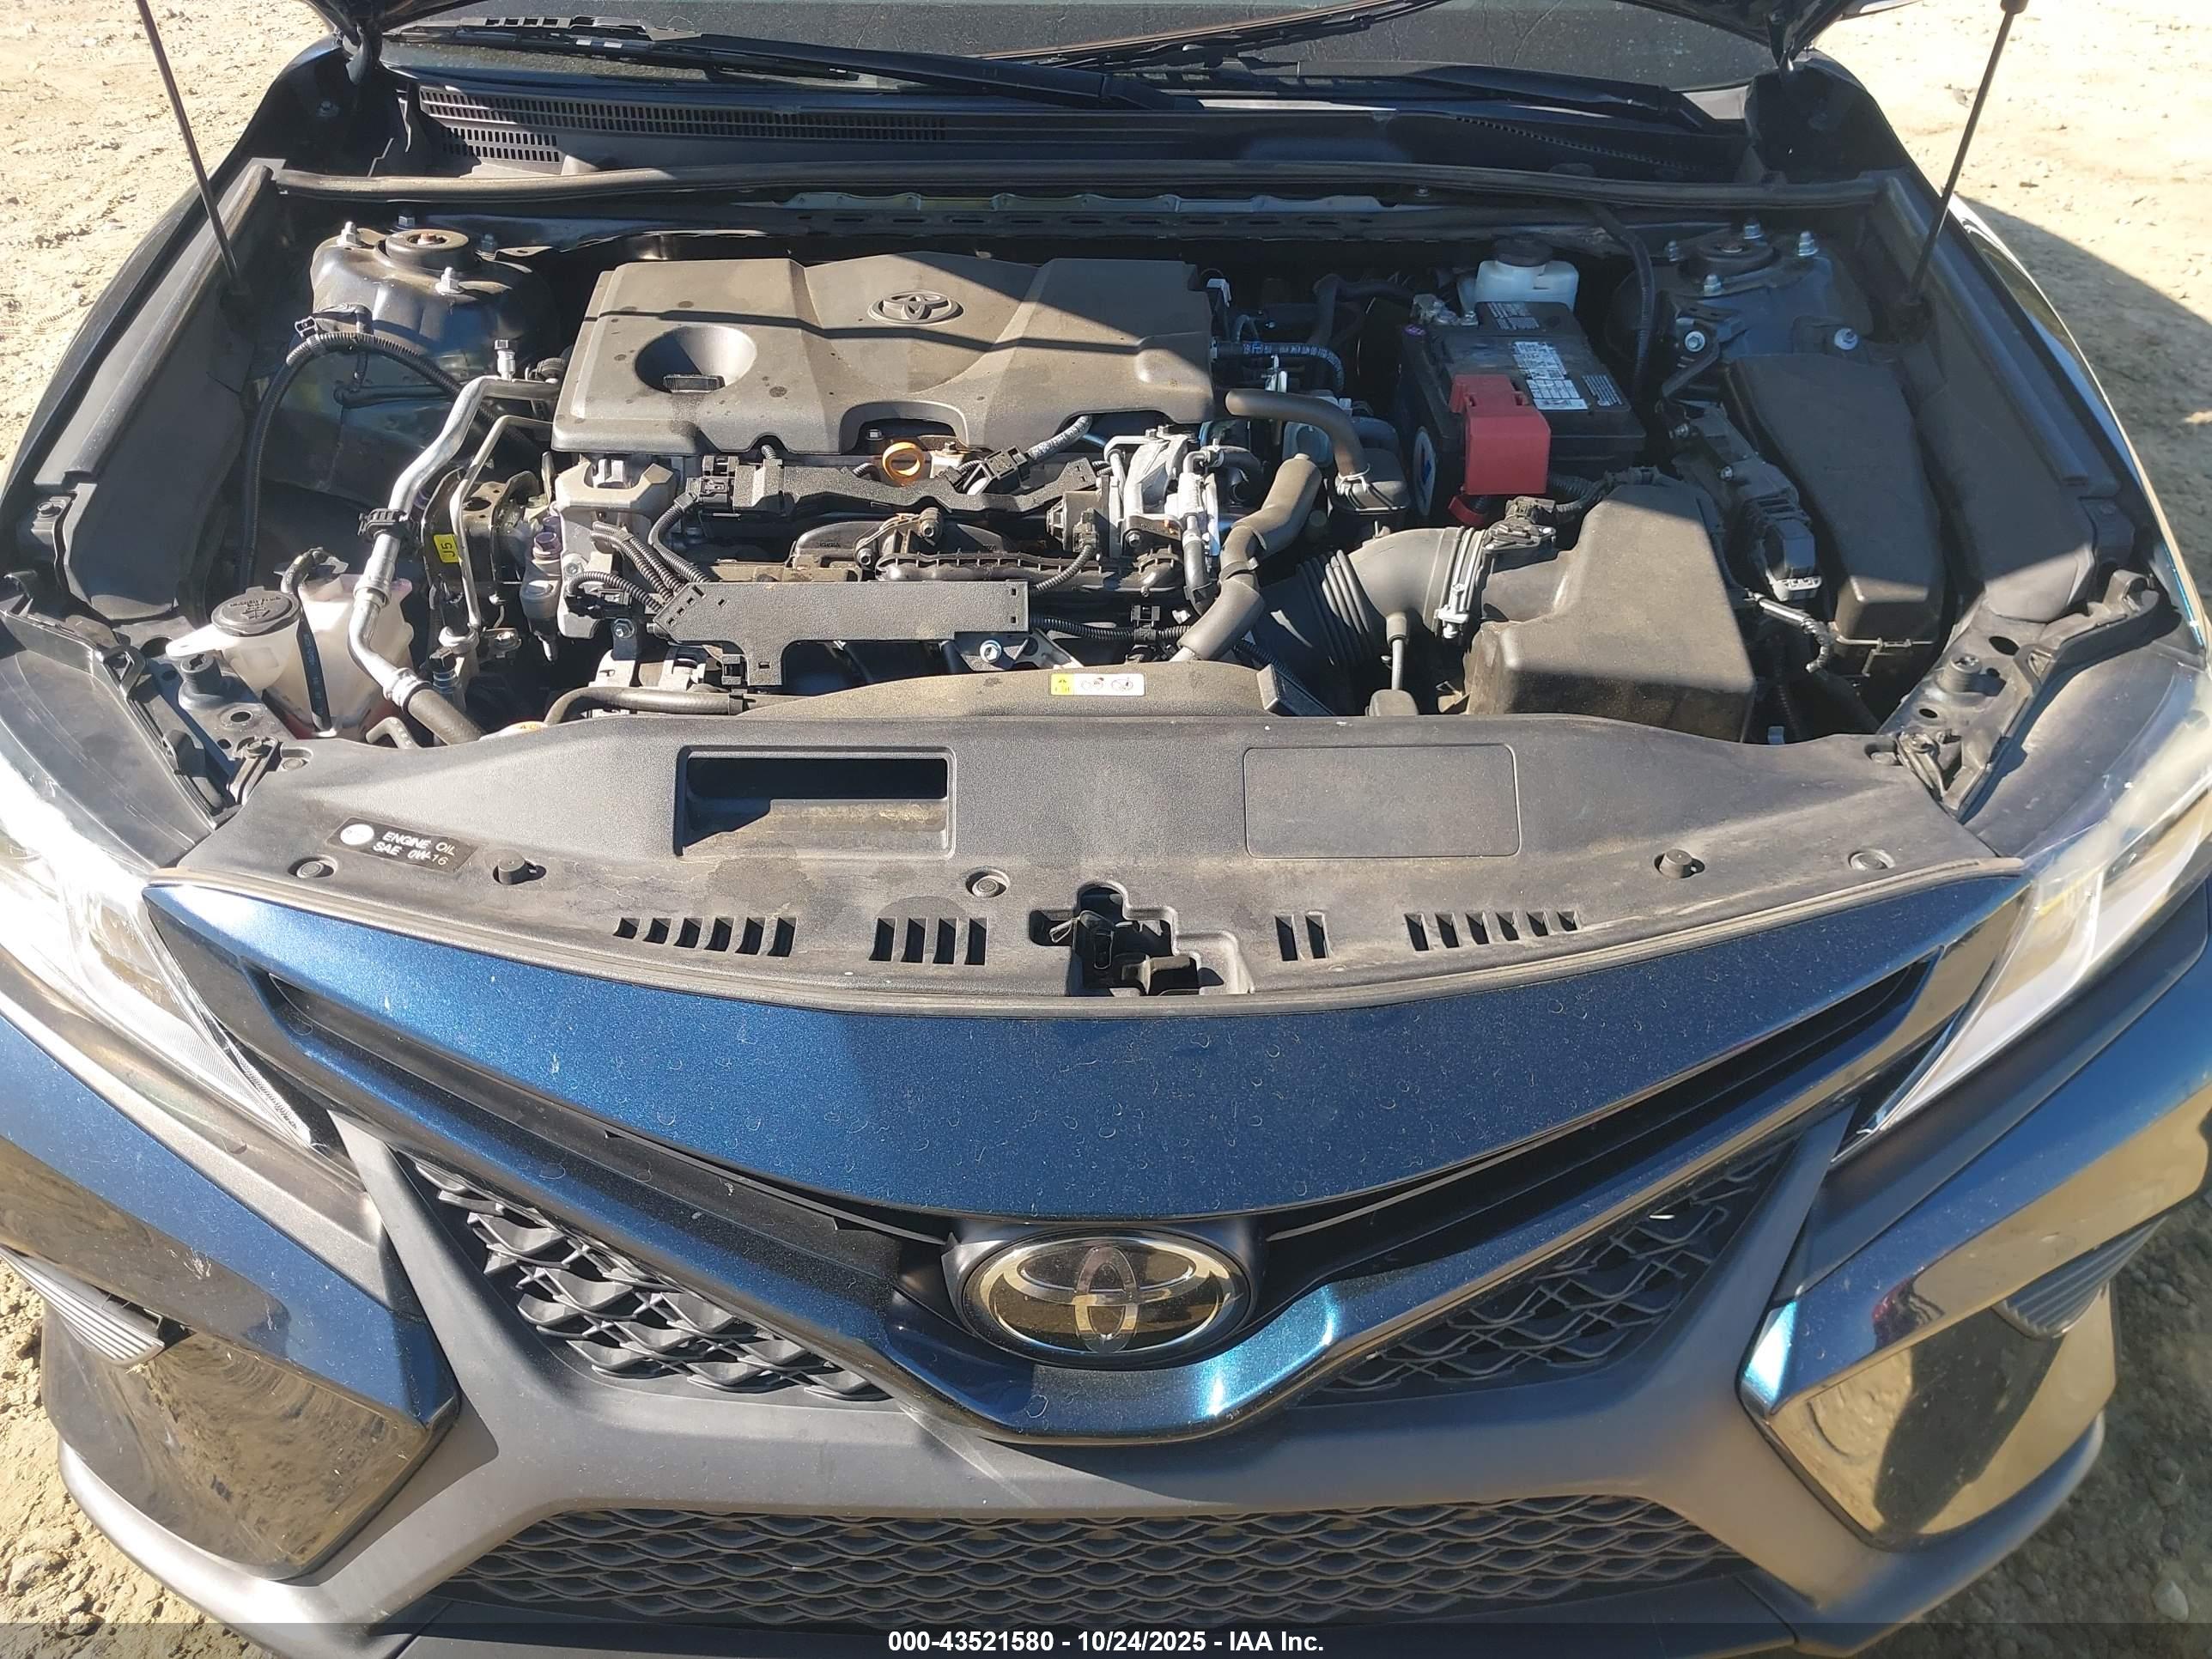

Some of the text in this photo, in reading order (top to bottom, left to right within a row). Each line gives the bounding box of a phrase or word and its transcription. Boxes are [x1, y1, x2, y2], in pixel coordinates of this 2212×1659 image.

[441, 542, 455, 557] J5
[373, 841, 448, 866] SAE 0W-16
[382, 830, 456, 856] ENGINE OIL
